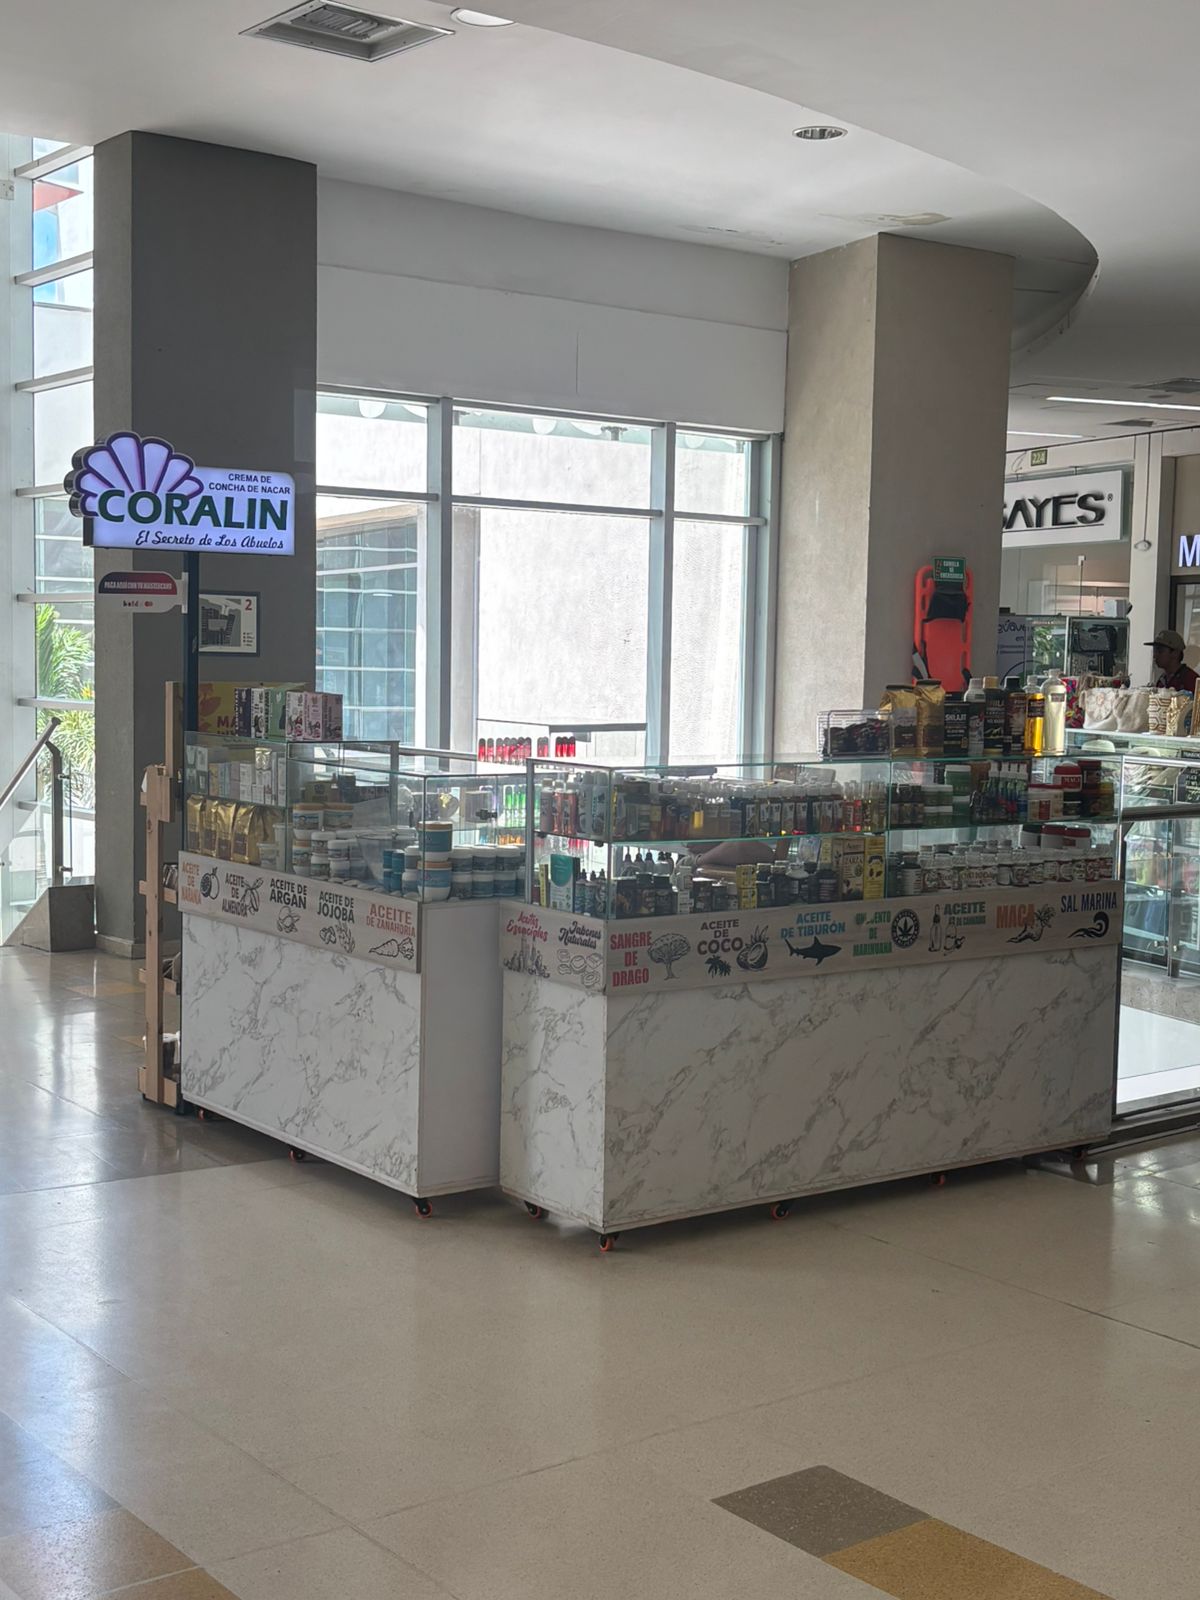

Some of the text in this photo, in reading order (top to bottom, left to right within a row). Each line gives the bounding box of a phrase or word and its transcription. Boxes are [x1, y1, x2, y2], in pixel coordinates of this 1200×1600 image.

[228, 473, 272, 484] CREMA DE
[209, 482, 291, 495] CONCHA DE NACAR
[98, 489, 289, 531] CORALIN
[135, 530, 284, 550] El Secreto de Los Abuelos
[245, 599, 252, 611] 2
[182, 861, 200, 876] ACEITE
[187, 875, 195, 887] DE
[225, 873, 245, 888] ACEITE
[270, 878, 307, 896] ACEITE DE
[231, 887, 239, 899] DE
[269, 889, 307, 910] ARGAN
[319, 891, 354, 909] ACEITE DE
[1060, 891, 1117, 913] SAL MARINA
[317, 902, 355, 924] JOJOBA
[370, 903, 412, 925] ACEITE
[796, 911, 832, 924] ACEITE
[944, 901, 986, 916] ACEITE
[366, 915, 416, 938] DE ZANAHORIA
[569, 921, 602, 940] Jabones
[700, 919, 740, 931] ACEITE
[713, 928, 729, 938] DE
[780, 918, 846, 940] DE TIBURÓN
[868, 927, 877, 939] DE
[558, 927, 597, 949] Naturales
[610, 931, 652, 950] SANGRE
[697, 937, 744, 956] COCO
[624, 950, 638, 966] DE
[612, 968, 649, 987] DRAGO
